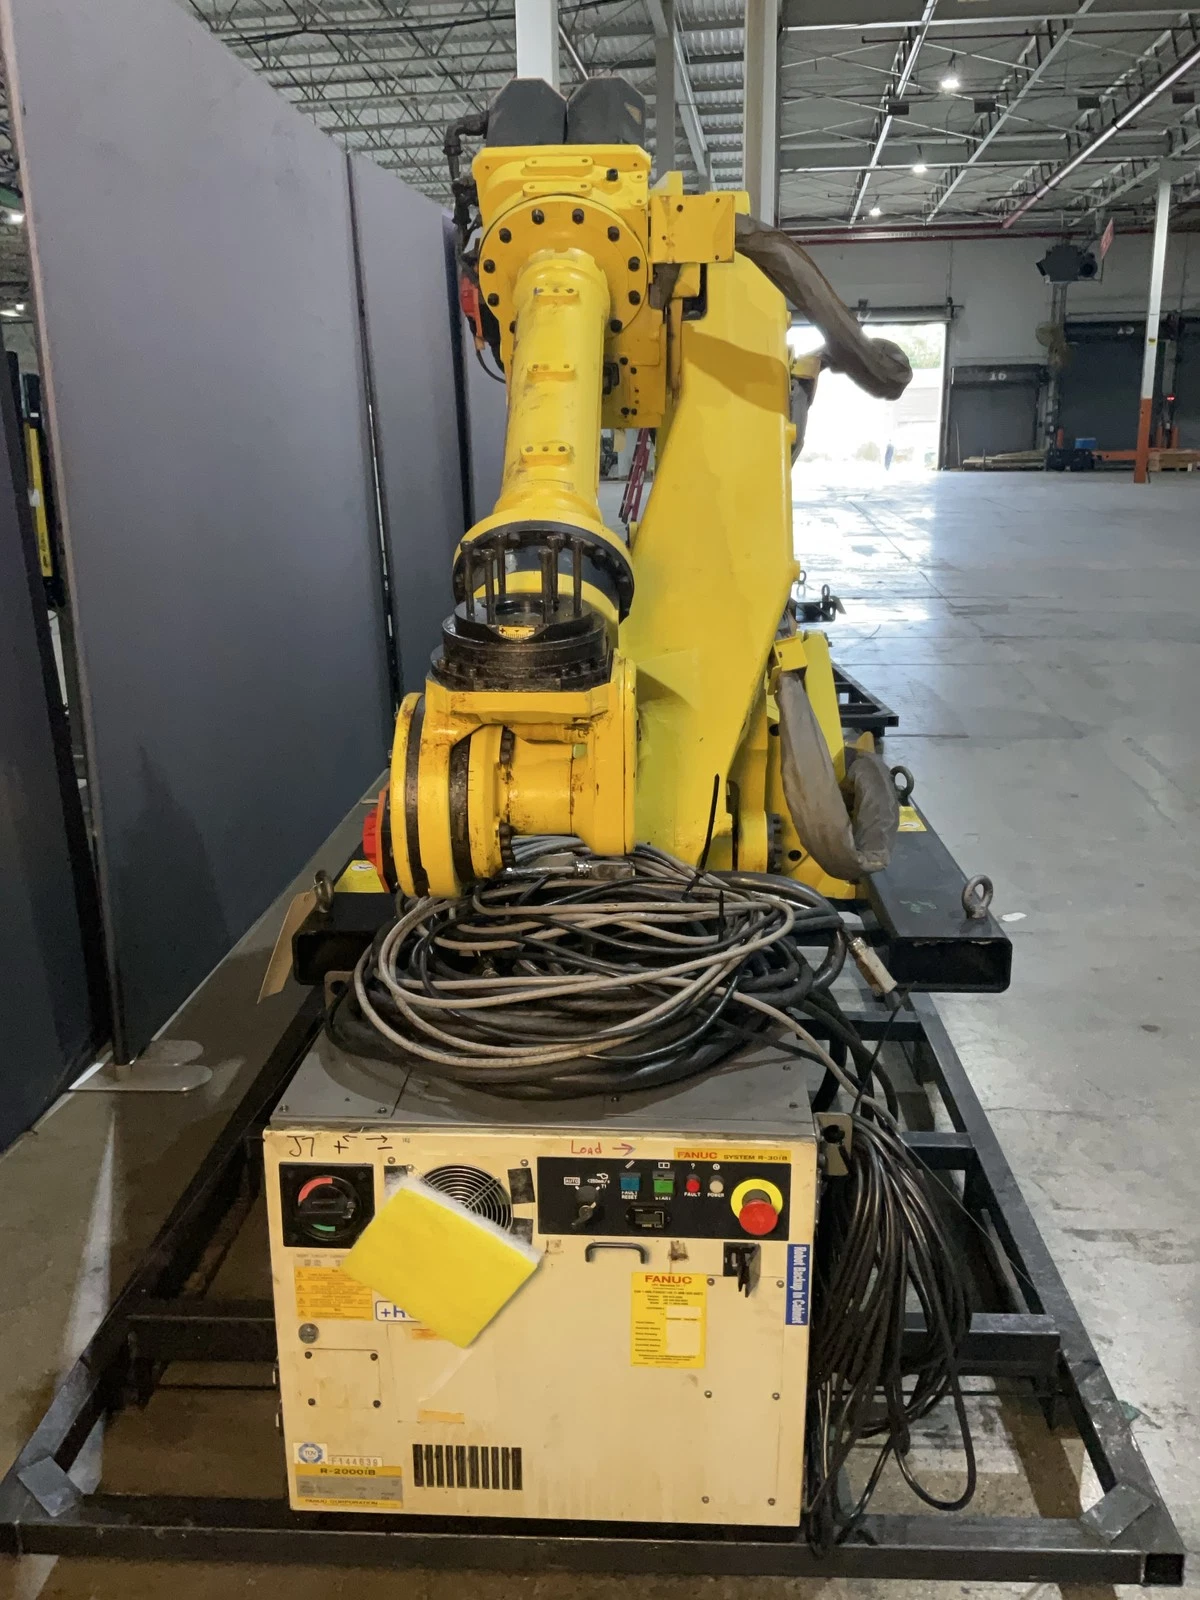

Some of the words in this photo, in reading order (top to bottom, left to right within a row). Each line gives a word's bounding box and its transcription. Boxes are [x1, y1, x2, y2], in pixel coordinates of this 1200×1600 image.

[286, 1135, 315, 1158] J7
[677, 1151, 718, 1160] FANUC
[644, 1275, 693, 1285] FANUC
